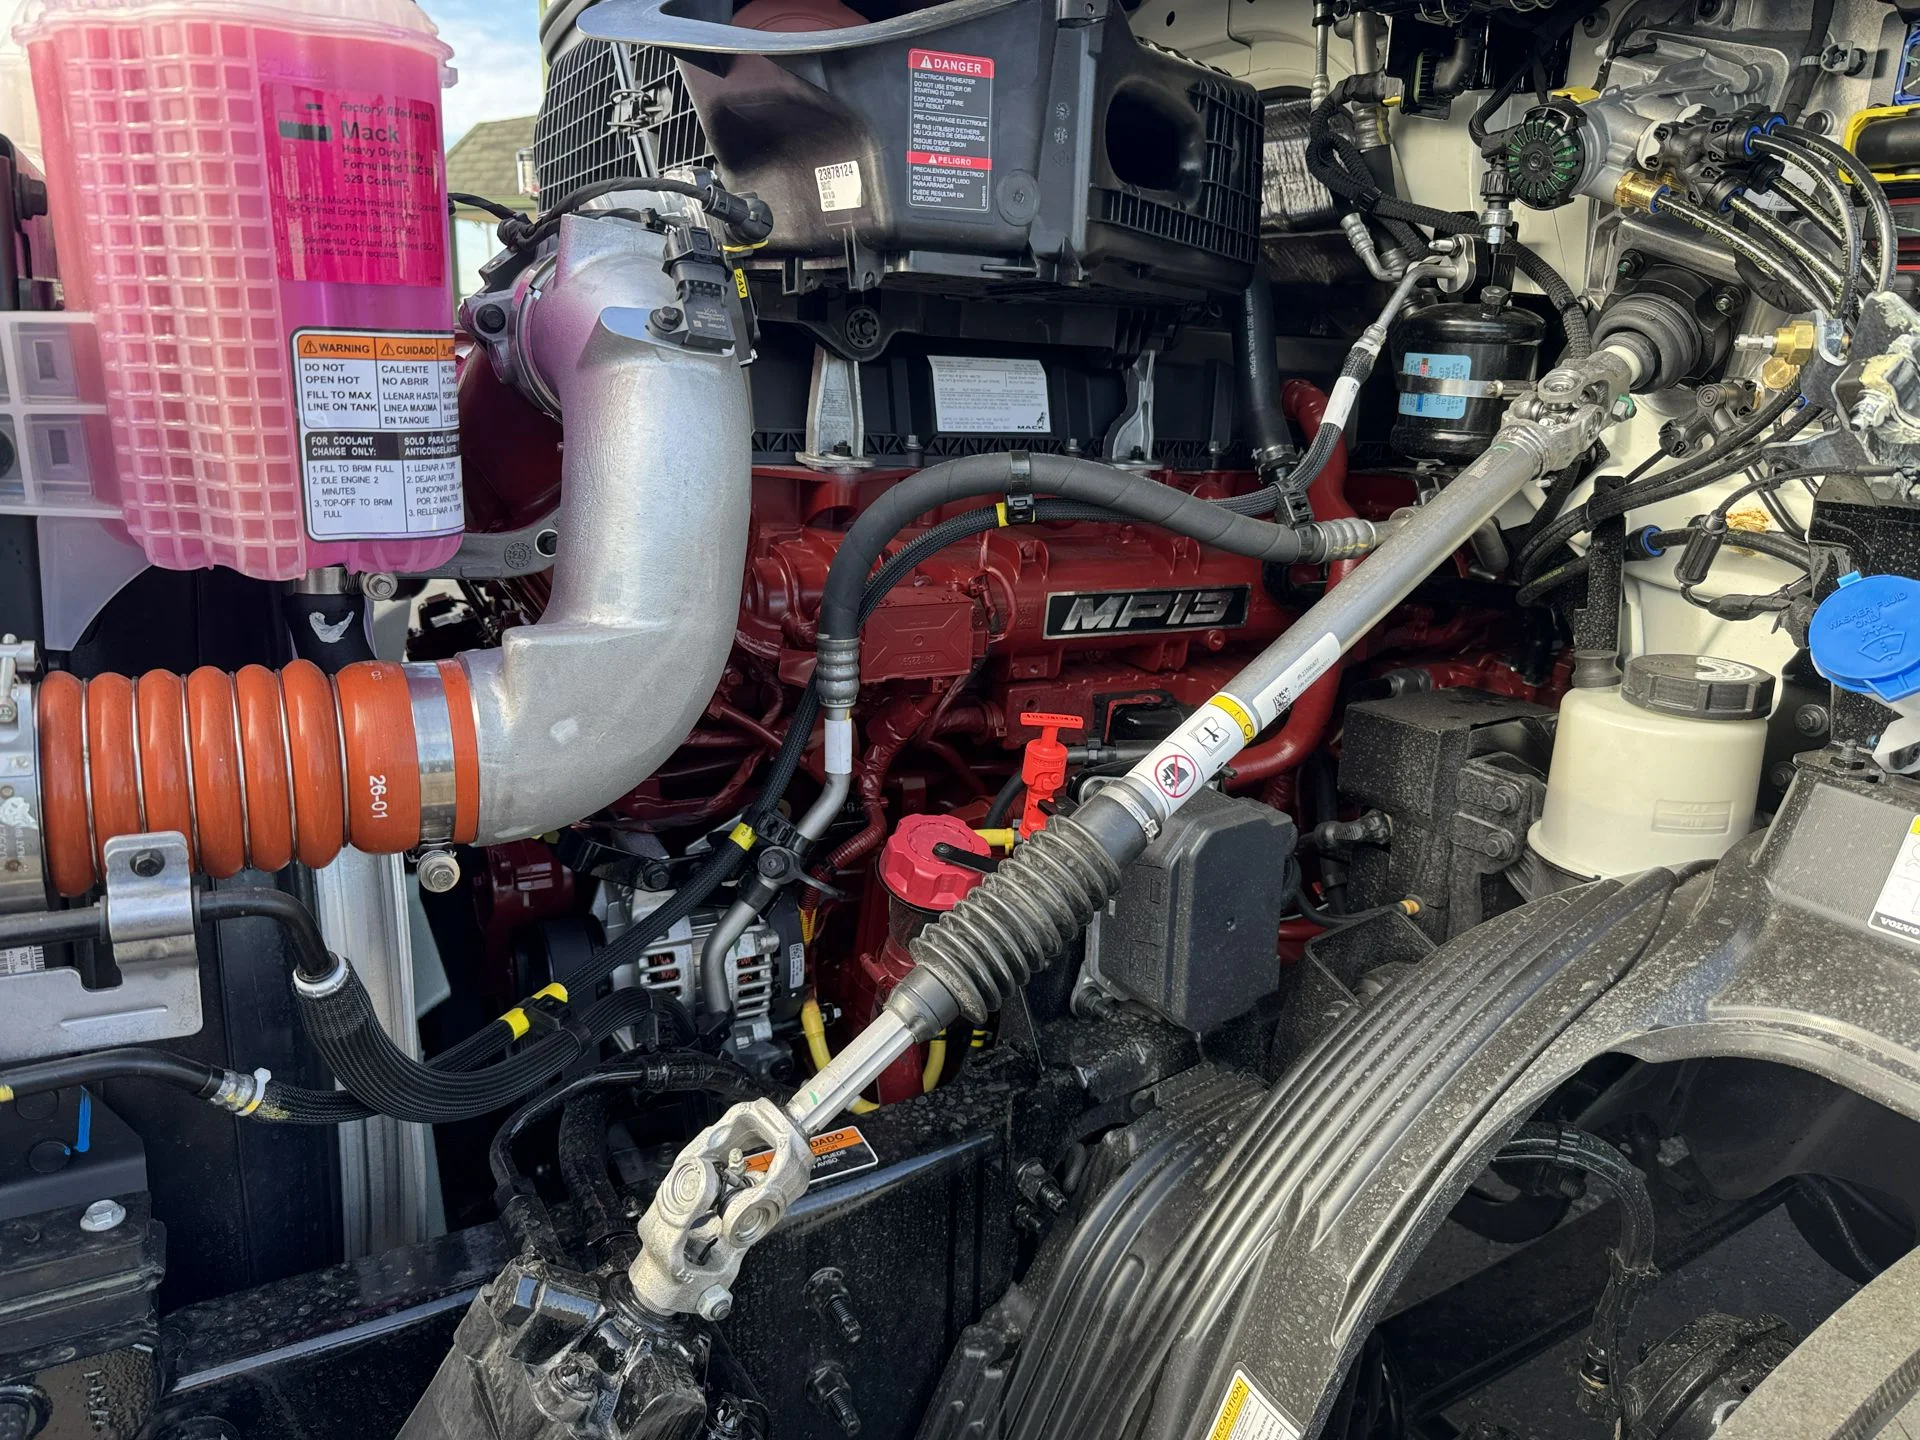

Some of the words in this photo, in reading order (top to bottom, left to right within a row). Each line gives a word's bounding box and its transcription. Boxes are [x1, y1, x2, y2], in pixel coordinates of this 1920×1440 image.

[934, 59, 981, 73] DANGER
[914, 72, 945, 81] ELECTRICAL
[340, 102, 383, 116] Factory
[414, 111, 431, 122] with
[913, 114, 955, 123] PRE-CHAUFFAGE
[341, 120, 399, 143] Mack
[922, 130, 945, 138] LIQUIDES
[954, 133, 985, 141] DEMARRAGE
[342, 144, 375, 158] Heavy
[378, 148, 401, 160] Duty
[938, 157, 971, 165] PELIGRO
[818, 164, 853, 180] 23878124
[913, 166, 956, 175] PRECALENTADOR
[344, 175, 363, 184] 329
[338, 208, 368, 217] Engine
[736, 272, 746, 294] 24V
[318, 343, 370, 353] WARNING
[396, 346, 437, 355] CUIDADO
[304, 363, 320, 372] DO
[322, 364, 345, 372] NOT
[382, 365, 429, 373] CALIENTE
[305, 376, 335, 384] OPEN
[338, 376, 360, 384] HOT
[382, 377, 398, 385] NO
[307, 391, 328, 399] FILL
[331, 391, 346, 399] TO
[349, 391, 372, 399] MAX
[383, 392, 415, 400] LLENAR
[417, 392, 439, 400] HASTA
[307, 403, 330, 411] LINE
[332, 403, 348, 411] ON
[350, 403, 378, 412] TANK
[384, 404, 408, 412] LINEA
[410, 404, 437, 412] MAXIMA
[384, 416, 397, 424] EN
[399, 416, 430, 424] TANQUE
[311, 436, 328, 445] FOR
[333, 437, 373, 445] COOLANT
[404, 437, 425, 445] SOLO
[428, 435, 444, 444] PARA
[312, 448, 346, 456] CHANGE
[351, 448, 377, 456] ONLY:
[405, 446, 457, 456] ANTICONGELANTE
[320, 465, 335, 473] FILL
[339, 465, 349, 473] TO
[352, 465, 372, 473] BRIM
[414, 463, 439, 472] LLENAR
[341, 476, 370, 484] ENGINE
[374, 476, 379, 484] 2
[415, 475, 437, 483] DEJAR
[324, 499, 356, 507] TOP-OFF
[417, 497, 431, 505] POR
[323, 510, 342, 518] FULL
[409, 509, 415, 517] 3.
[417, 506, 448, 516] RELLENAR
[1061, 592, 1234, 631] MP13
[1831, 607, 1873, 630] WASHER
[1877, 592, 1908, 607] FLUID
[1856, 613, 1880, 628] ONLY
[369, 775, 388, 820] 26-01
[1679, 818, 1704, 826] MIN
[1880, 916, 1920, 935] VOLVO
[822, 1150, 847, 1160] PUEDE
